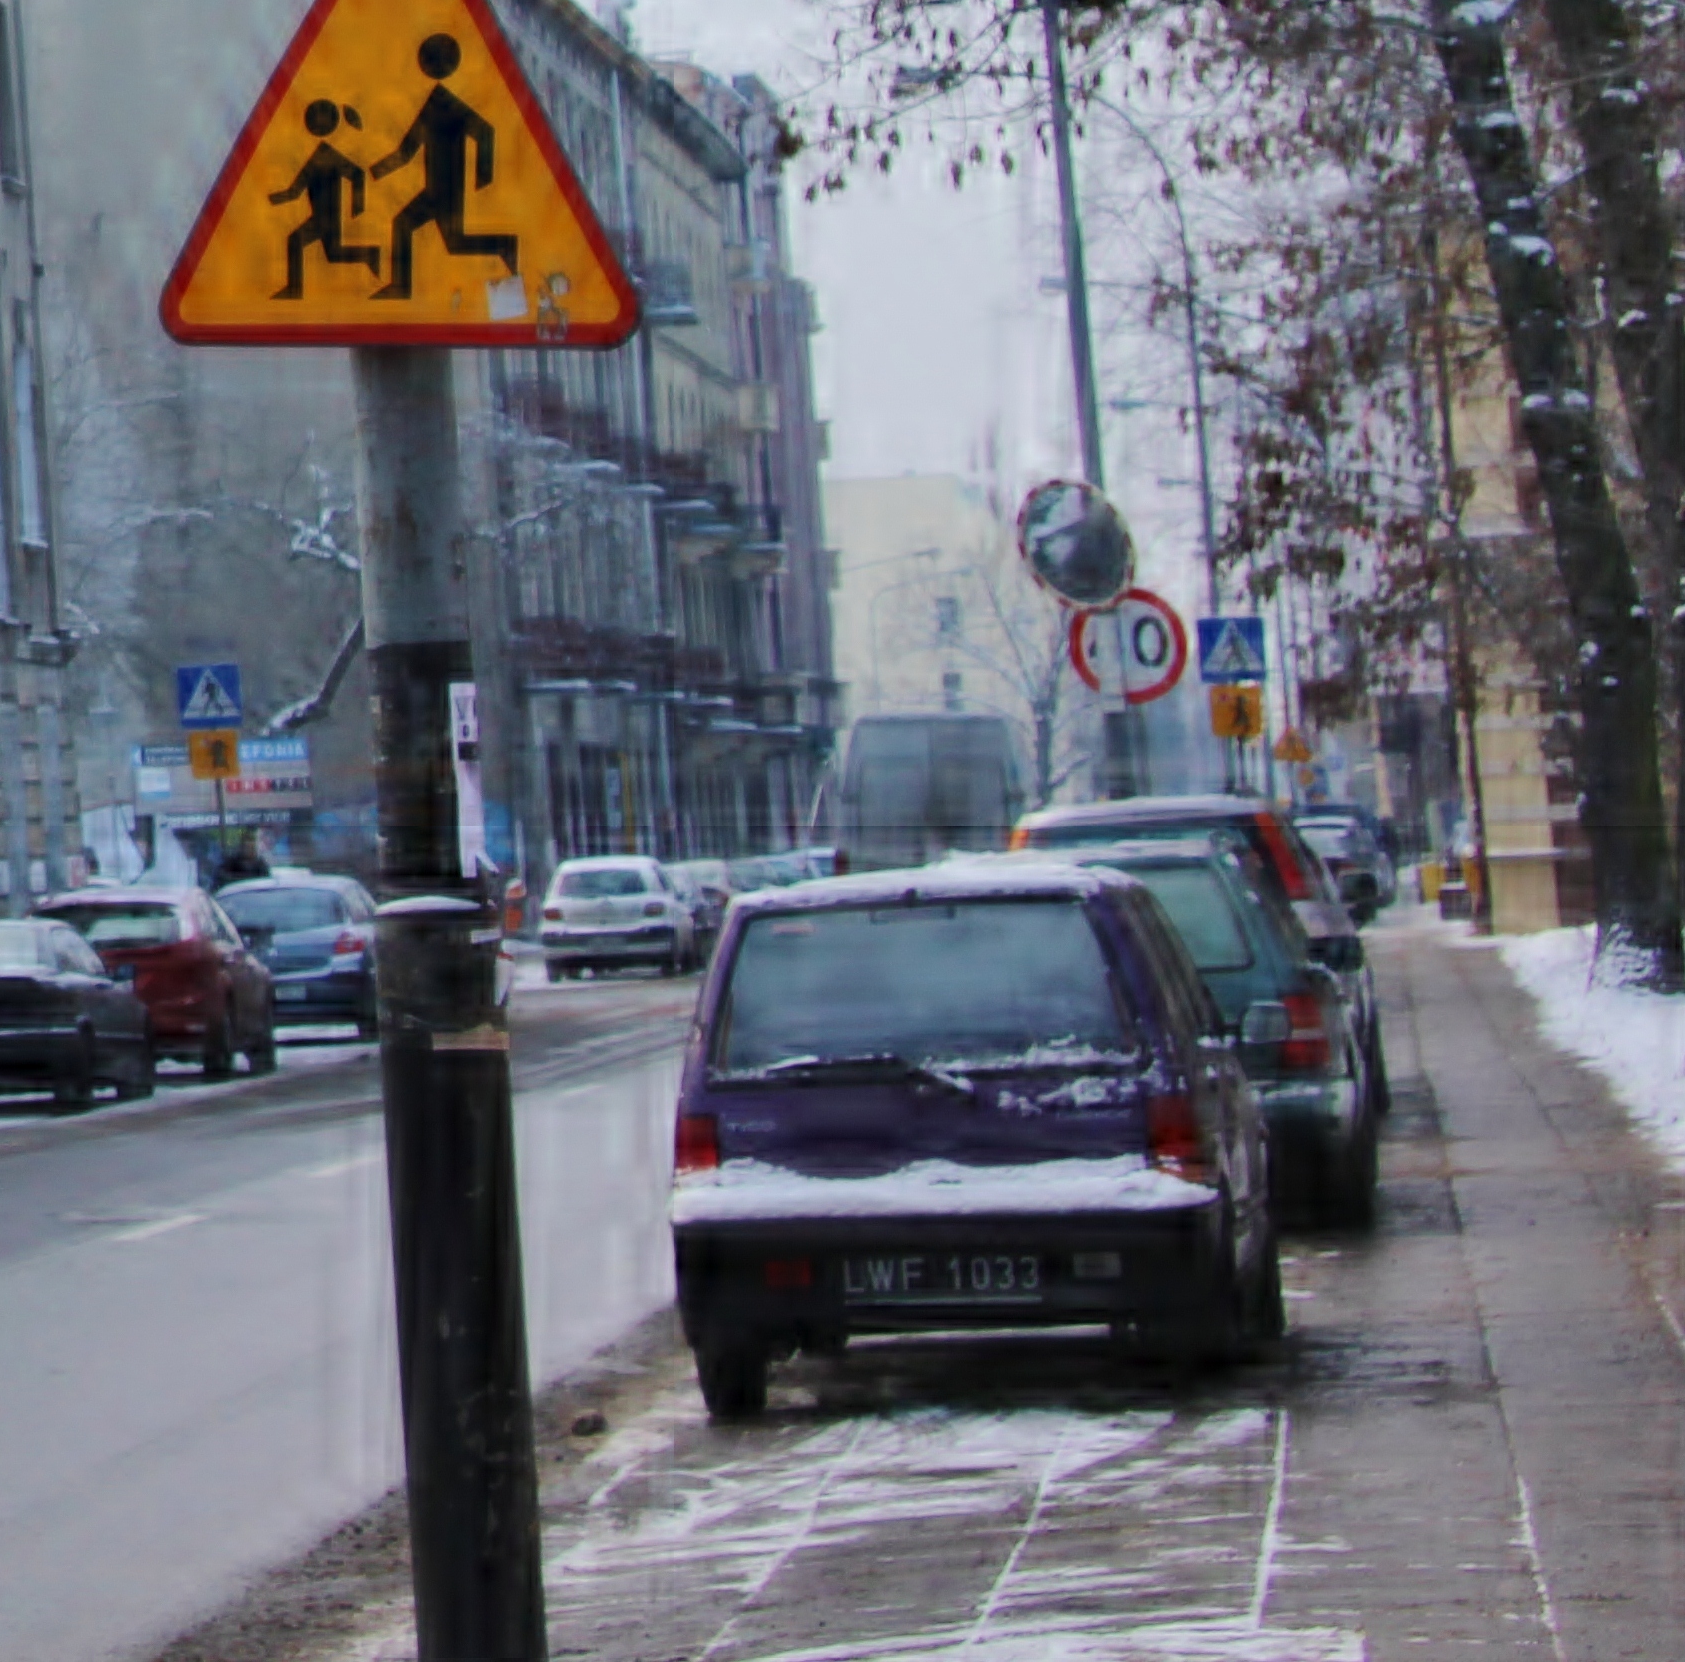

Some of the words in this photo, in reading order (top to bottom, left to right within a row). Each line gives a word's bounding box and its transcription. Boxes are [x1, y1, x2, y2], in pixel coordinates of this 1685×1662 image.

[239, 742, 305, 759] EFONIA
[843, 1257, 924, 1292] LWF
[948, 1256, 1040, 1289] 1033
